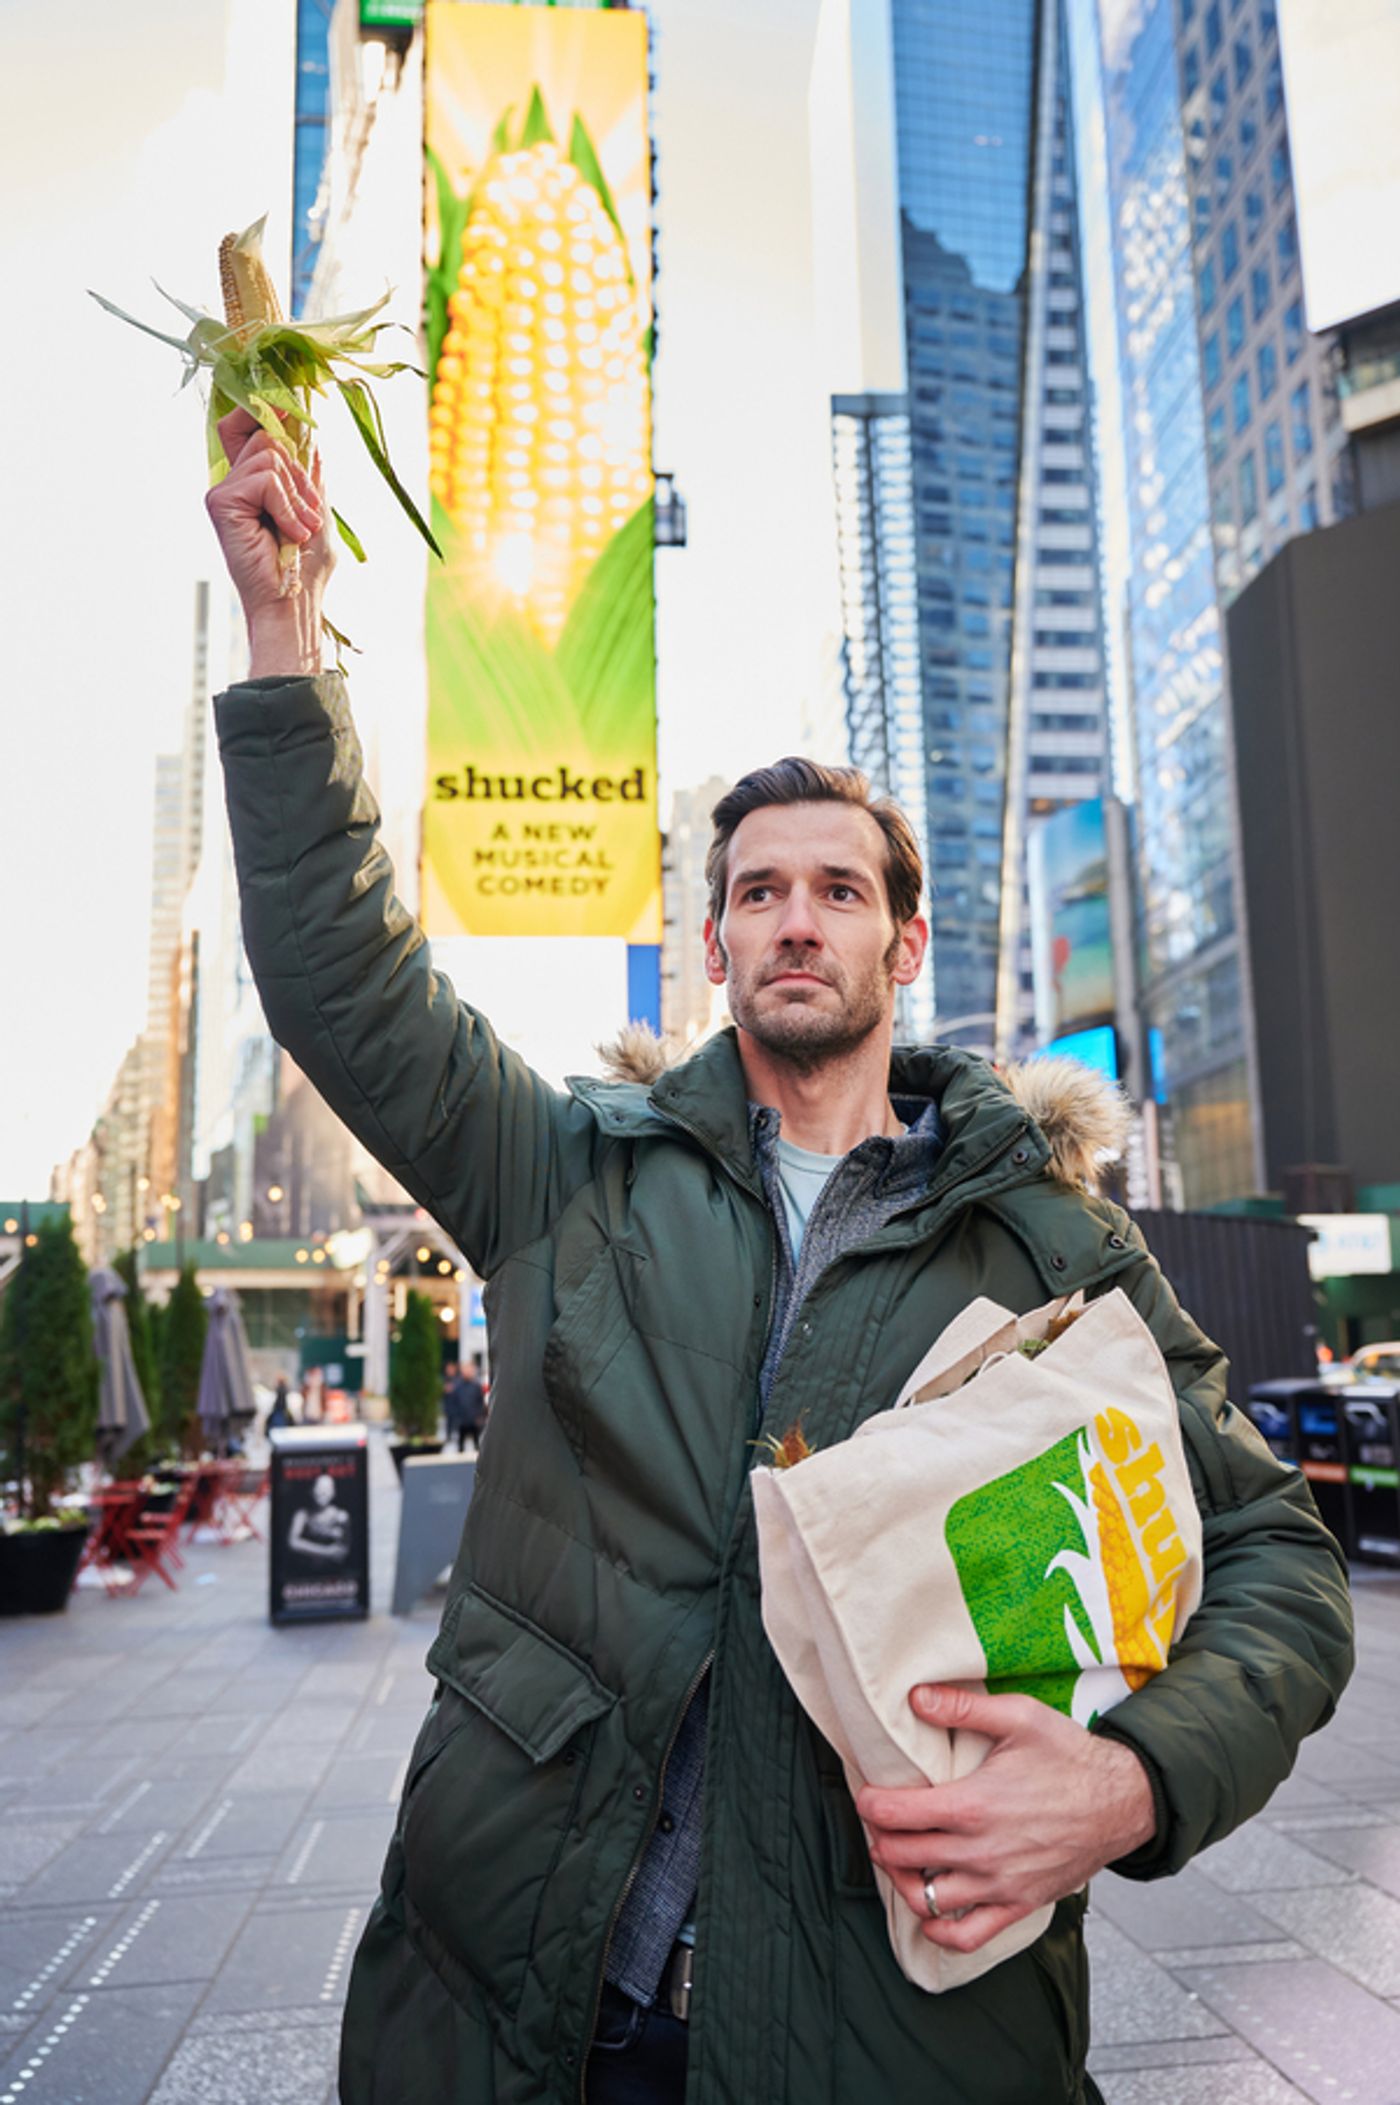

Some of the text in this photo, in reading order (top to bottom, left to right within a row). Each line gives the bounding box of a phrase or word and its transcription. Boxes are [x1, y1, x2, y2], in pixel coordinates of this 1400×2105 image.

[435, 767, 646, 801] shucked
[492, 824, 595, 841] A NEW
[473, 850, 613, 869] MUSICAL
[476, 876, 609, 896] COMEDY
